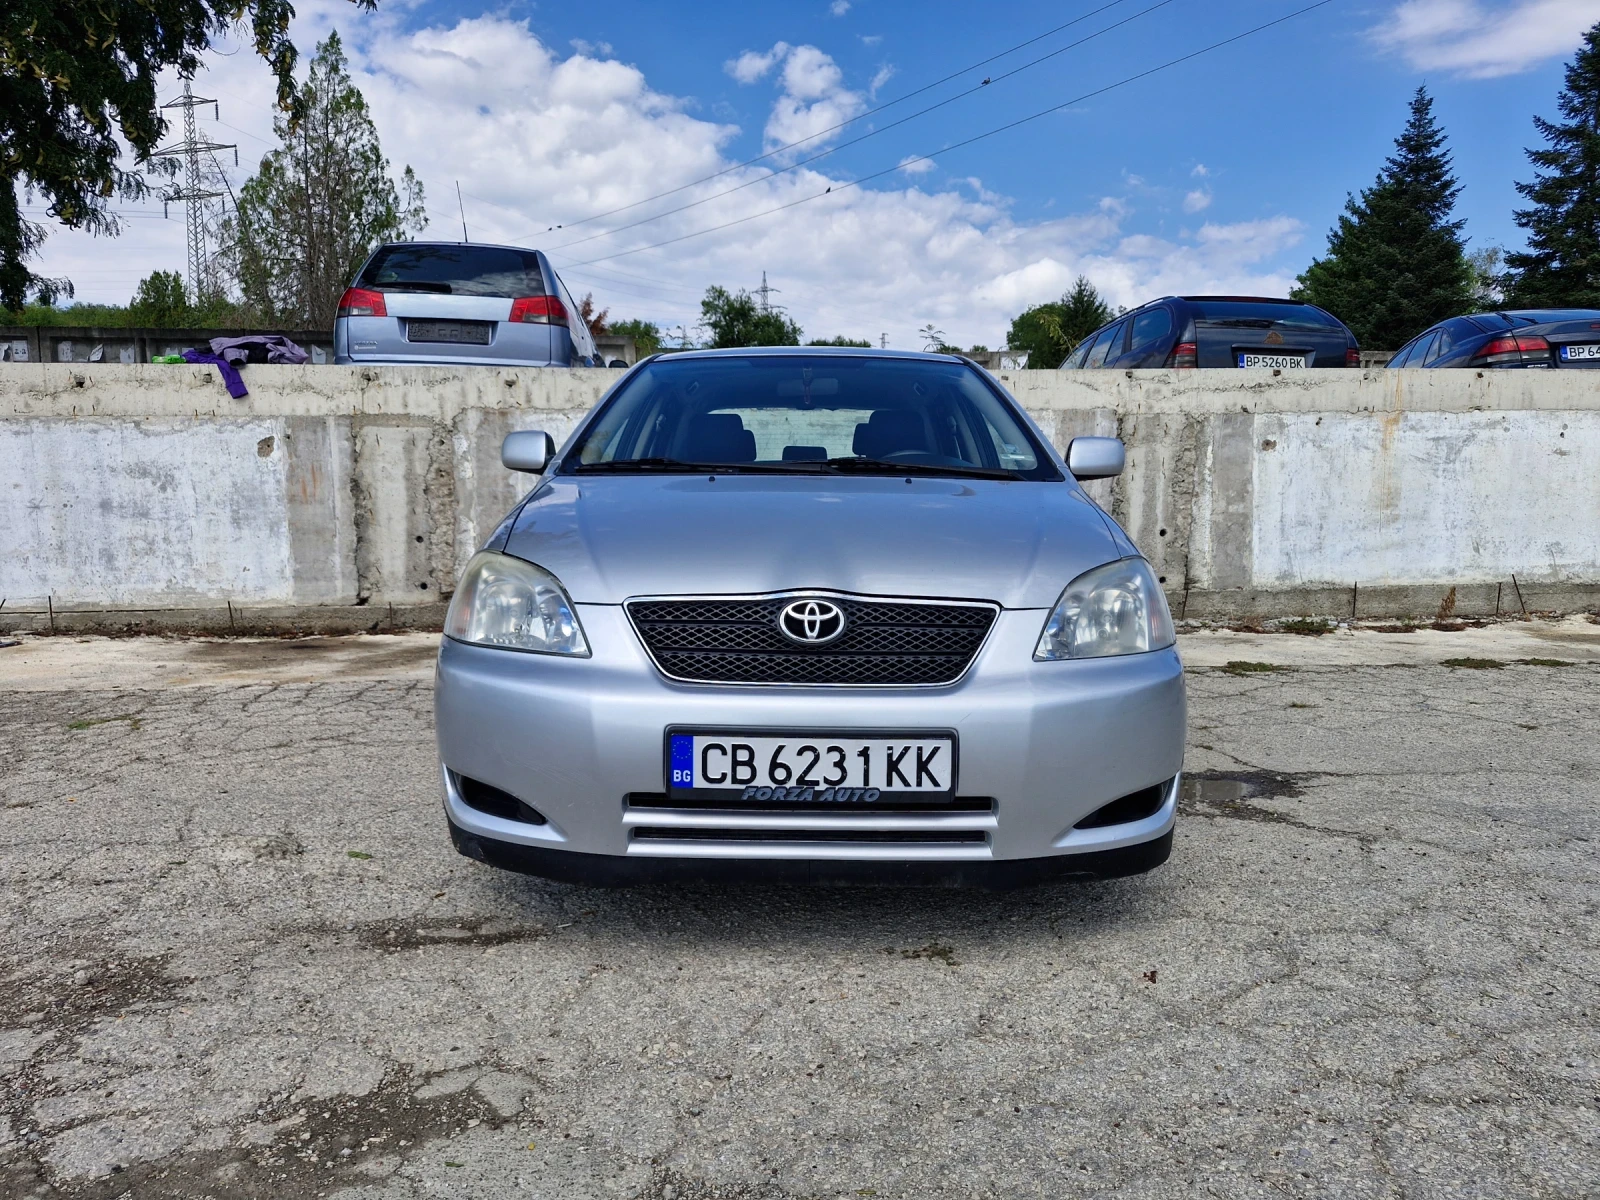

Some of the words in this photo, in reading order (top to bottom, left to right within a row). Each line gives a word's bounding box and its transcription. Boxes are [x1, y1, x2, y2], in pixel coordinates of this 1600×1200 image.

[1569, 347, 1585, 357] BP
[1246, 356, 1260, 368] BP
[1262, 357, 1288, 368] 5260
[1289, 358, 1303, 369] BK
[701, 743, 757, 785] CB
[768, 744, 871, 787] 6231
[886, 746, 941, 788] KK
[673, 769, 691, 782] BG
[741, 786, 815, 801] FORZA
[819, 787, 881, 802] AUTO
